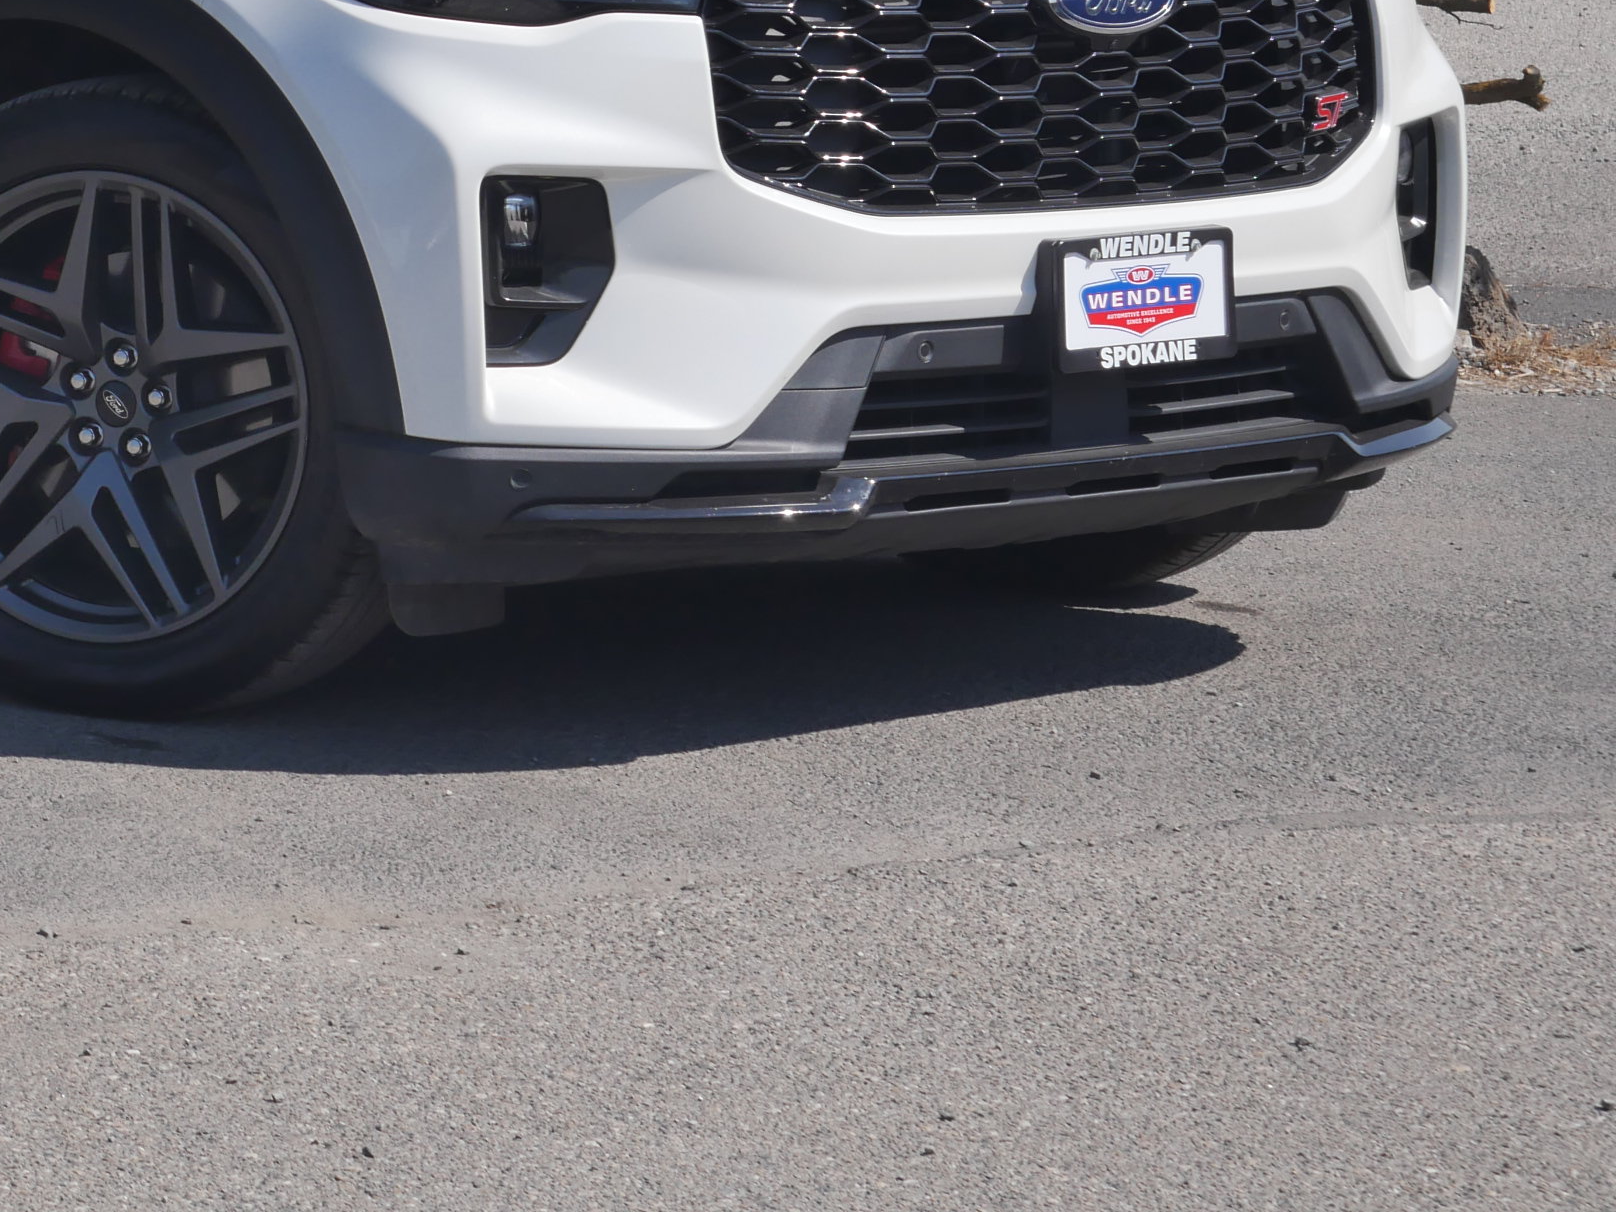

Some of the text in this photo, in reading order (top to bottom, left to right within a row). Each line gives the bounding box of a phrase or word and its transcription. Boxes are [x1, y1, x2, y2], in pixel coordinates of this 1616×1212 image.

[1312, 91, 1349, 132] ST
[1099, 231, 1192, 259] WENDLE
[1131, 269, 1150, 282] W
[1087, 284, 1193, 310] WENDLE
[1106, 307, 1174, 320] AUTOMOTIVE EXCELLENCE
[1100, 339, 1198, 369] SPOKANE
[105, 394, 125, 415] Ford
